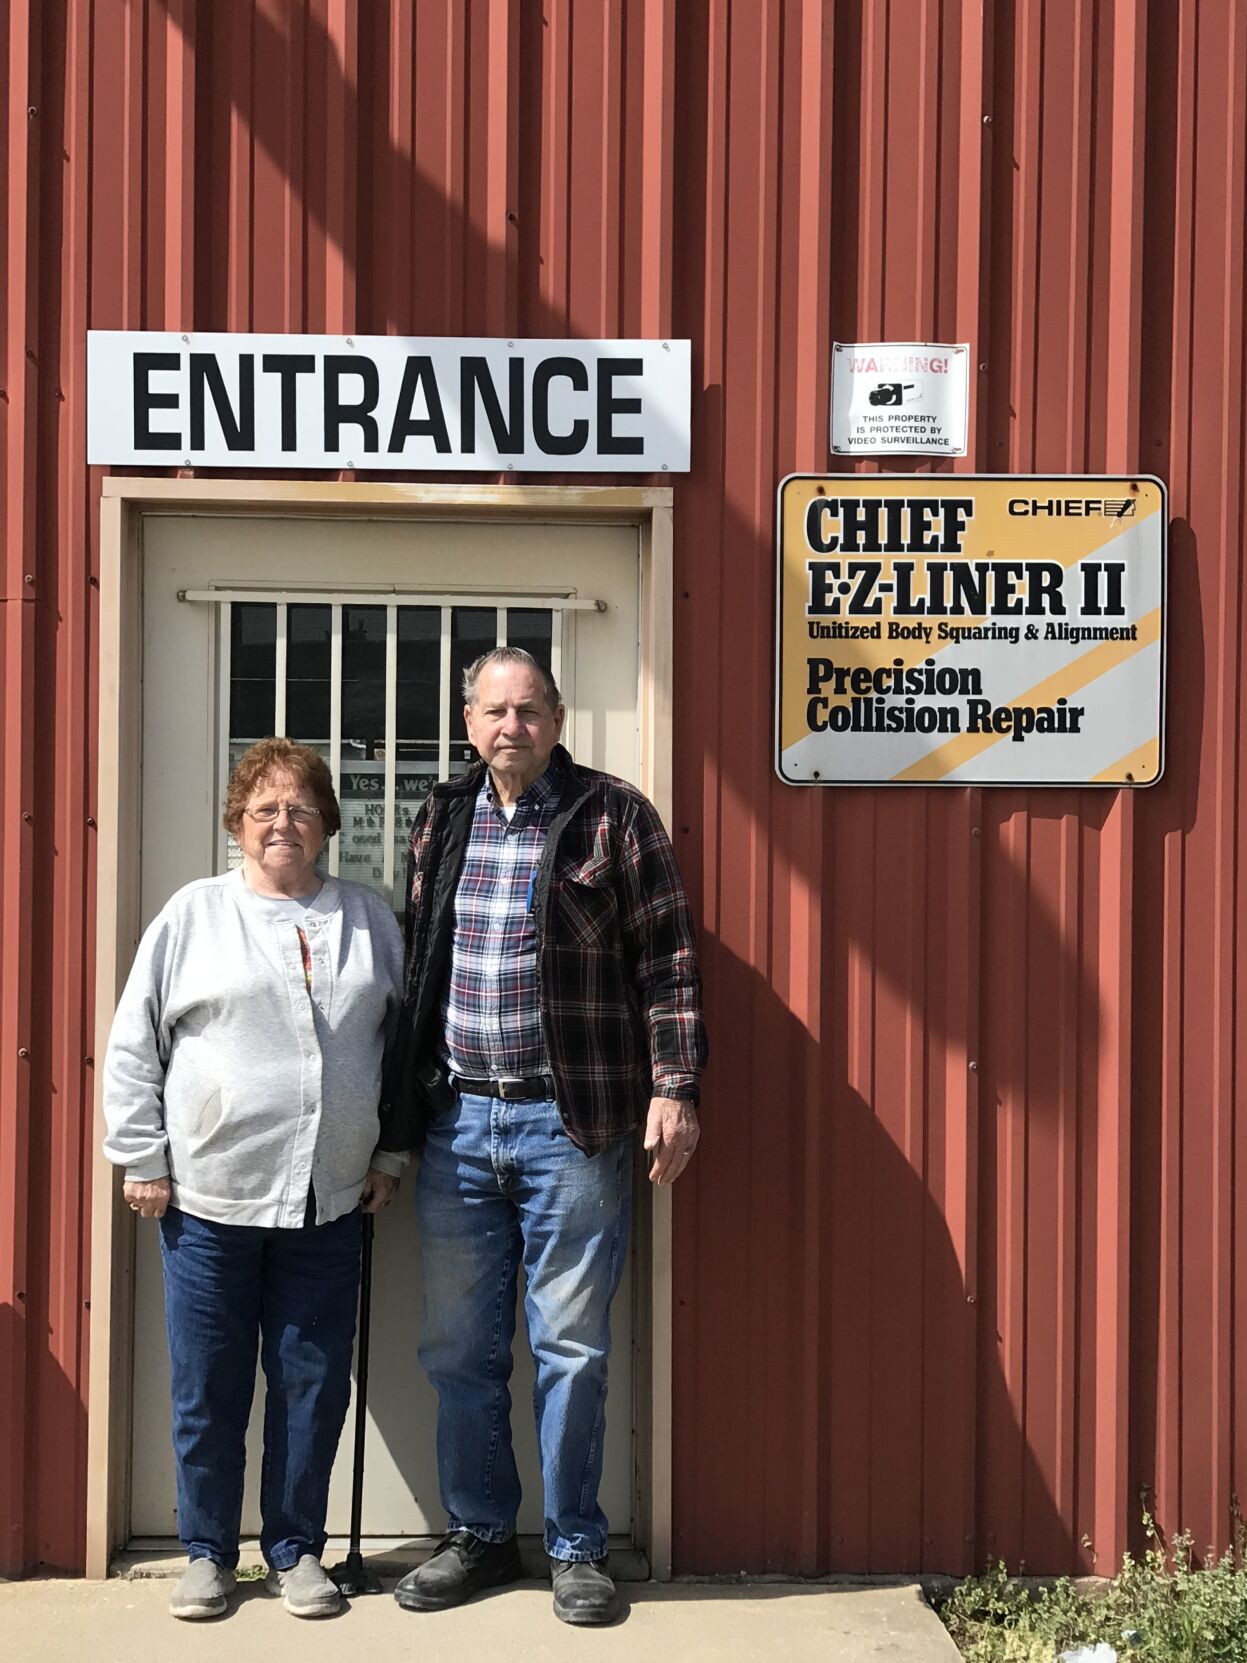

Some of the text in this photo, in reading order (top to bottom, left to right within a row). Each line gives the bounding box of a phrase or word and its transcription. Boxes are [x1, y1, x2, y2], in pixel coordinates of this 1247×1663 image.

[847, 357, 949, 374] WARNING!
[133, 352, 644, 455] ENTRANCE
[857, 425, 942, 434] IS PROTECTED BY
[862, 414, 937, 423] THIS PROPERTY
[848, 436, 950, 446] VIDEO SURVEILLANCE
[1008, 499, 1102, 516] CHIEF
[806, 498, 973, 553] CHIEF
[1080, 562, 1126, 616] II
[807, 621, 1138, 645] Unitized Body Squaring & Alignment
[806, 657, 983, 696] Precision
[806, 696, 1085, 742] Collision Repair
